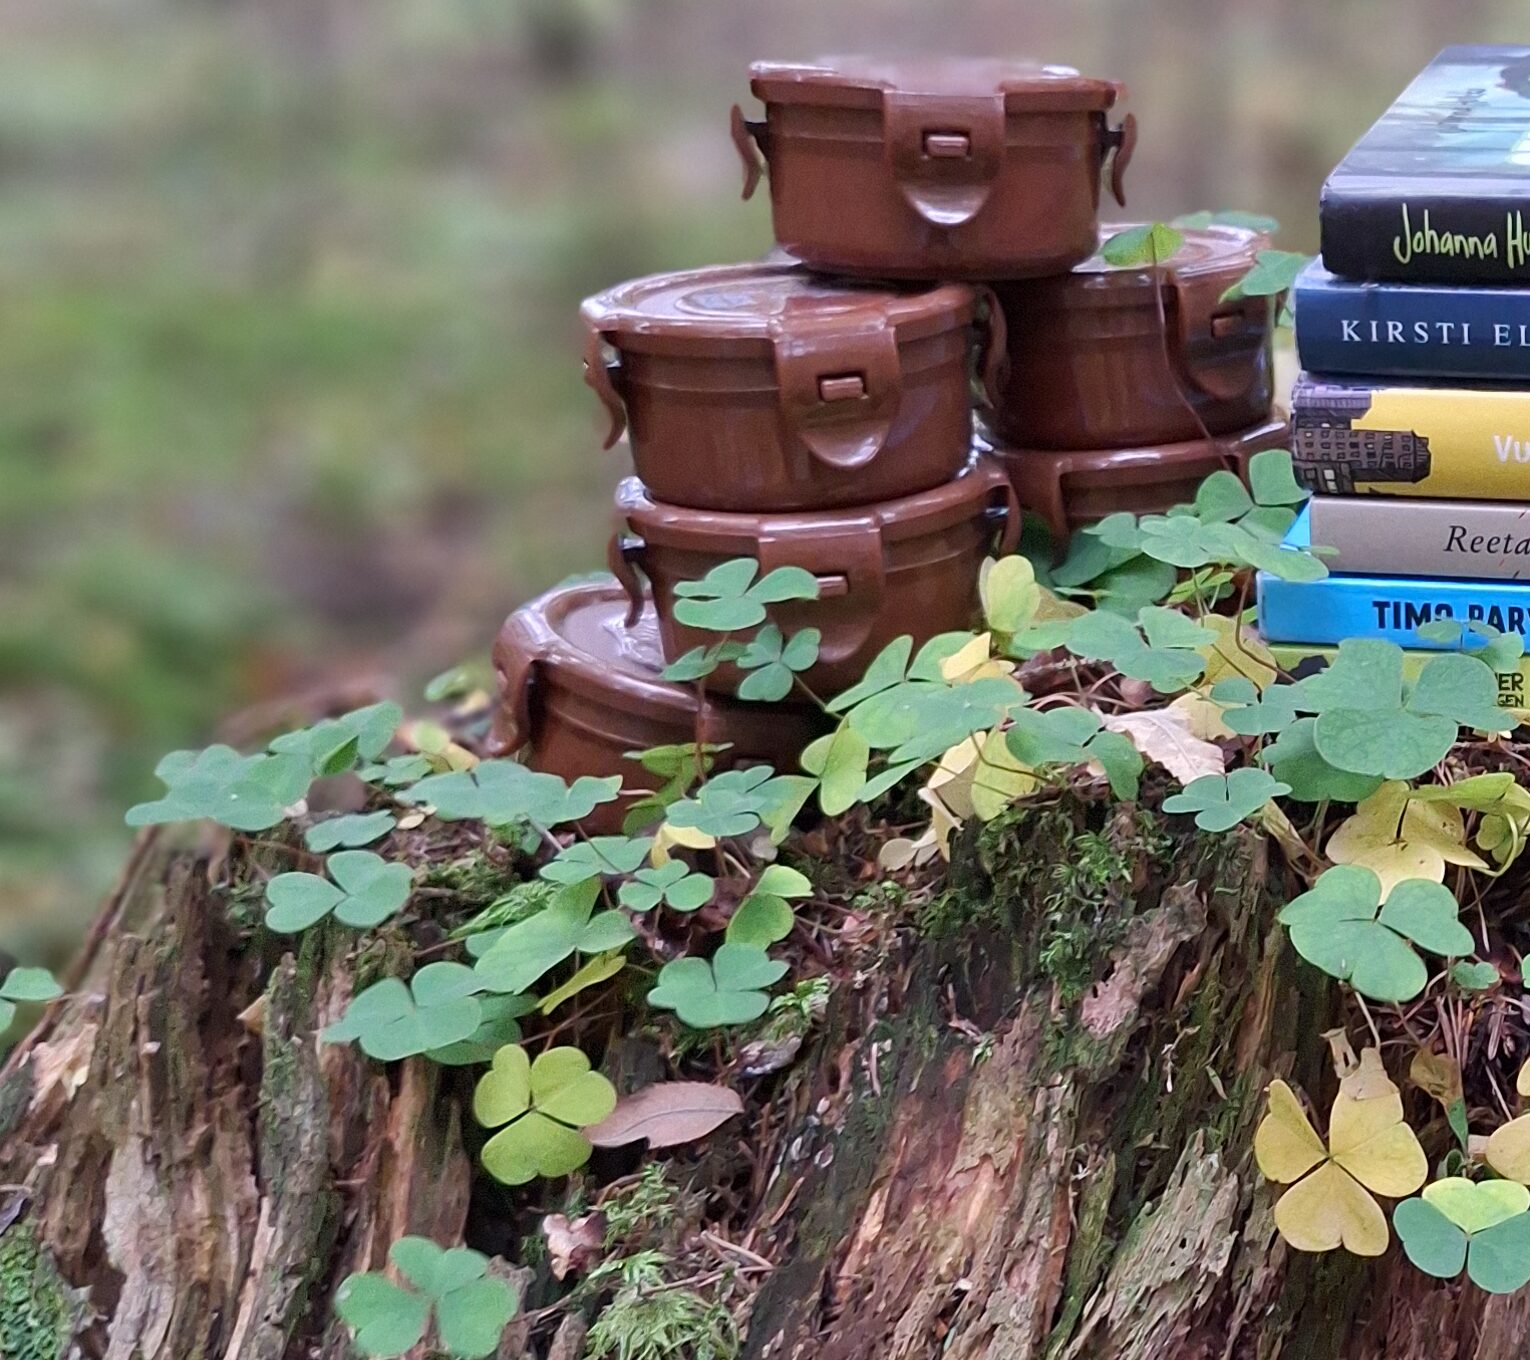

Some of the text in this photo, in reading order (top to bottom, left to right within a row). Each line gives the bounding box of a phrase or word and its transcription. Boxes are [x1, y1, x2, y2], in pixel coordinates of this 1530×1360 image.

[1393, 203, 1498, 264] Johanna
[1341, 320, 1471, 345] KIRSTI
[1372, 600, 1453, 631] TIMO
[1495, 672, 1524, 691] ER
